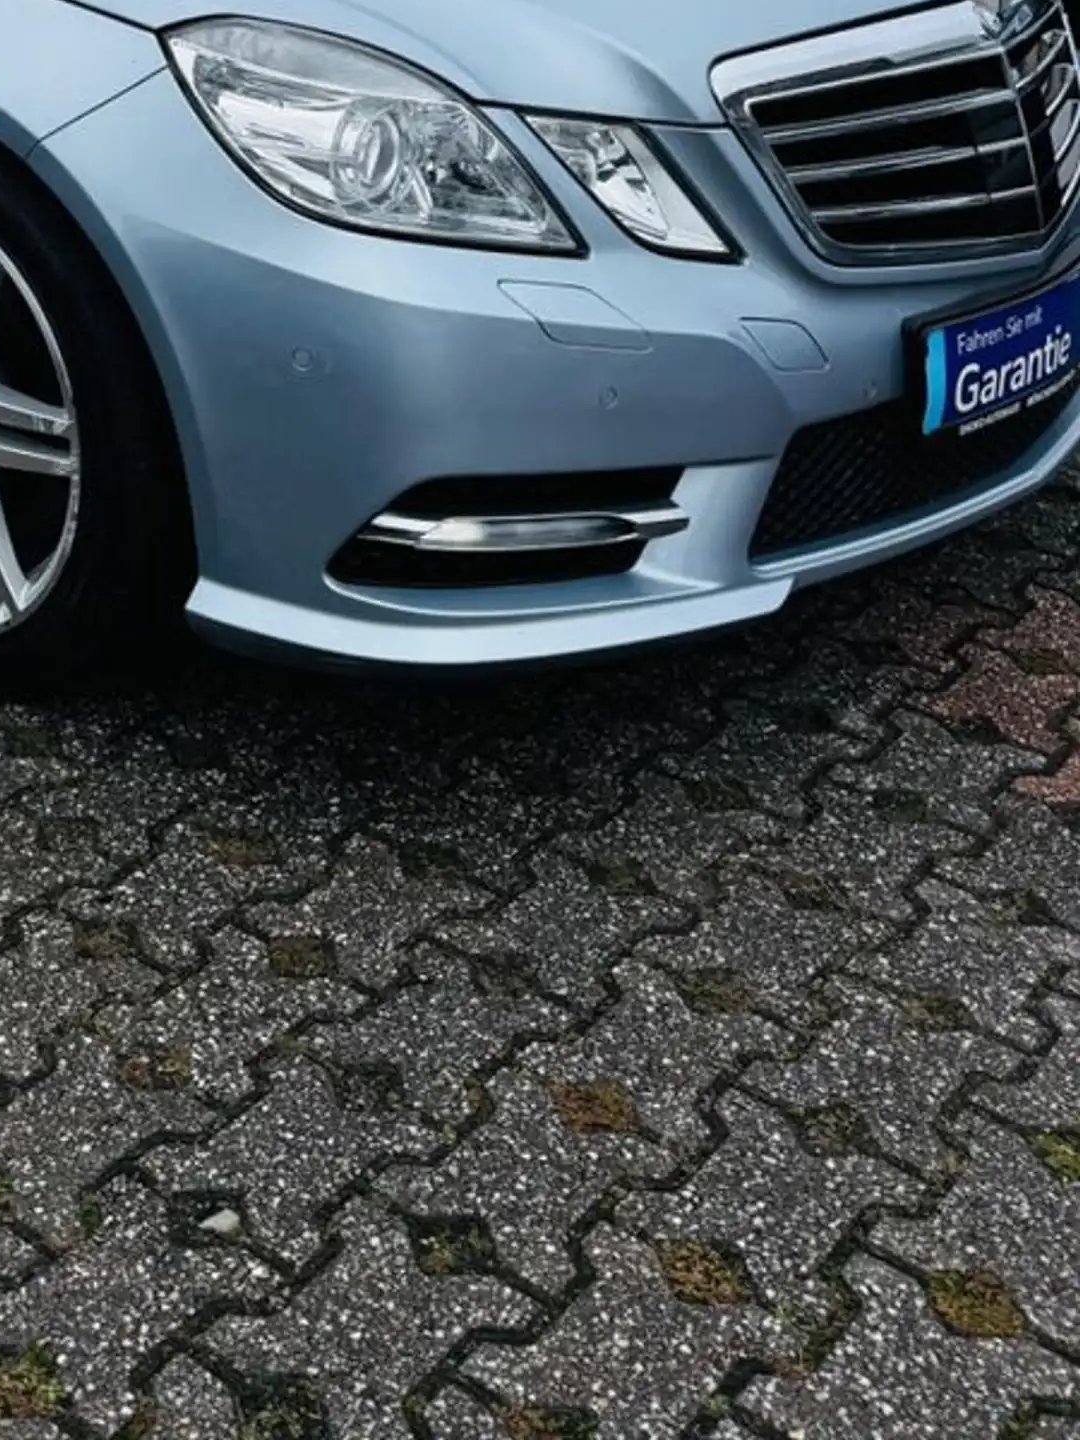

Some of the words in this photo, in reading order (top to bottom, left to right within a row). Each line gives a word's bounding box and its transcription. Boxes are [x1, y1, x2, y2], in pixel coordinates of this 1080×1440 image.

[956, 327, 1005, 356] Fahren
[1005, 314, 1024, 339] Sie
[1024, 304, 1043, 330] mit
[954, 324, 1072, 414] Garantie
